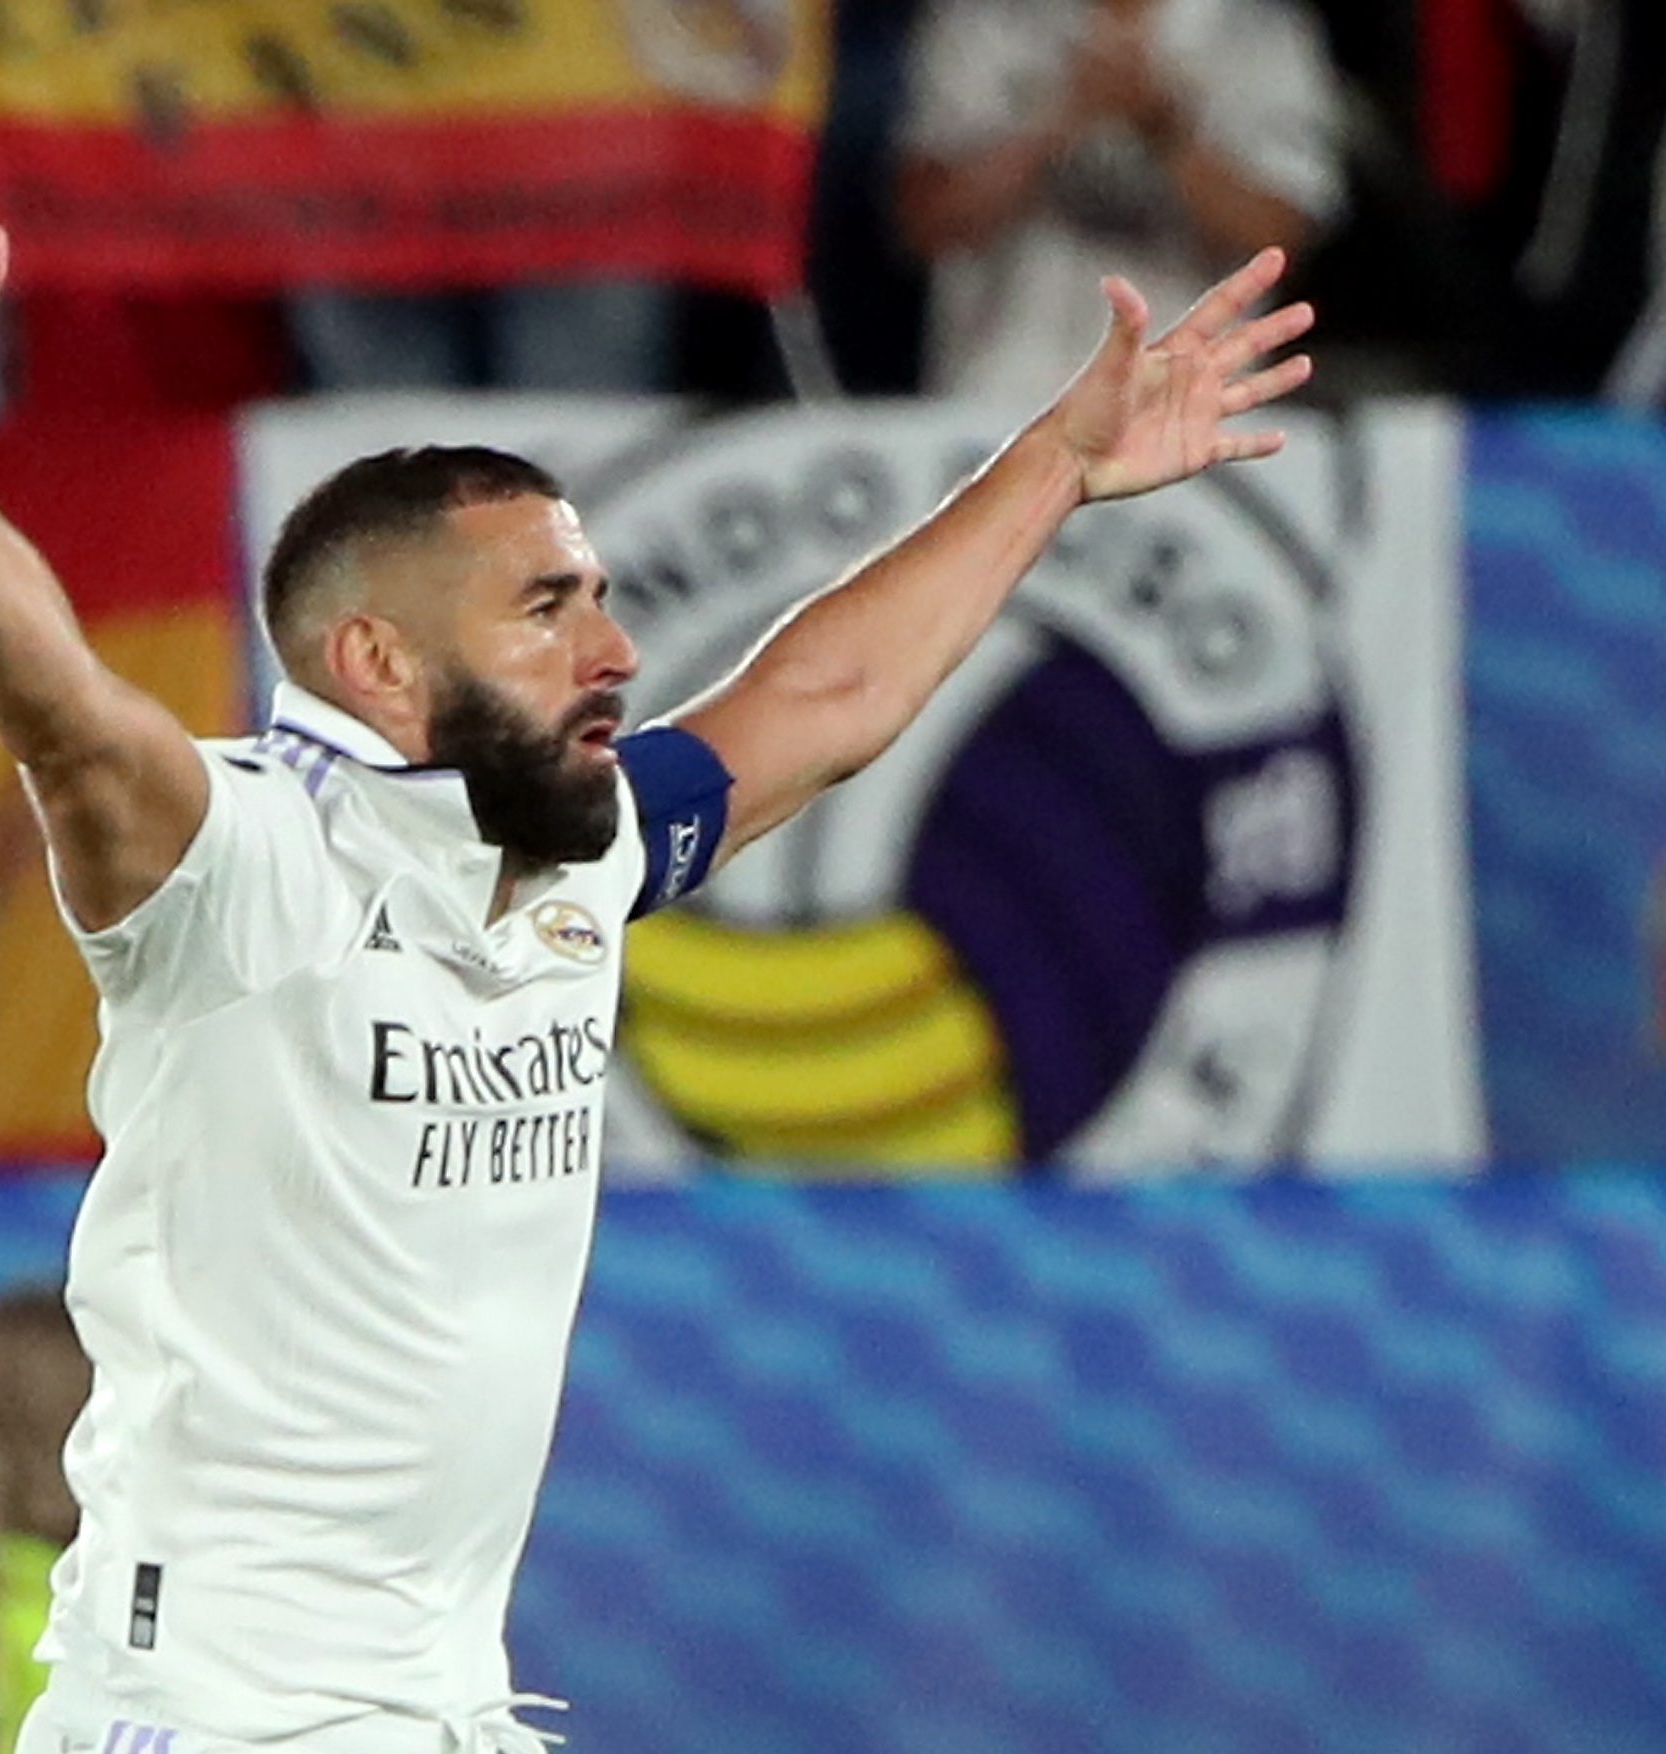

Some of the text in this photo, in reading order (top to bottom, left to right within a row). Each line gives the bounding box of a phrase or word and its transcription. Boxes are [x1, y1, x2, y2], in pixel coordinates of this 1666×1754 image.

[370, 1016, 609, 1104] Emirates
[412, 1106, 590, 1188] FLY BETTER
